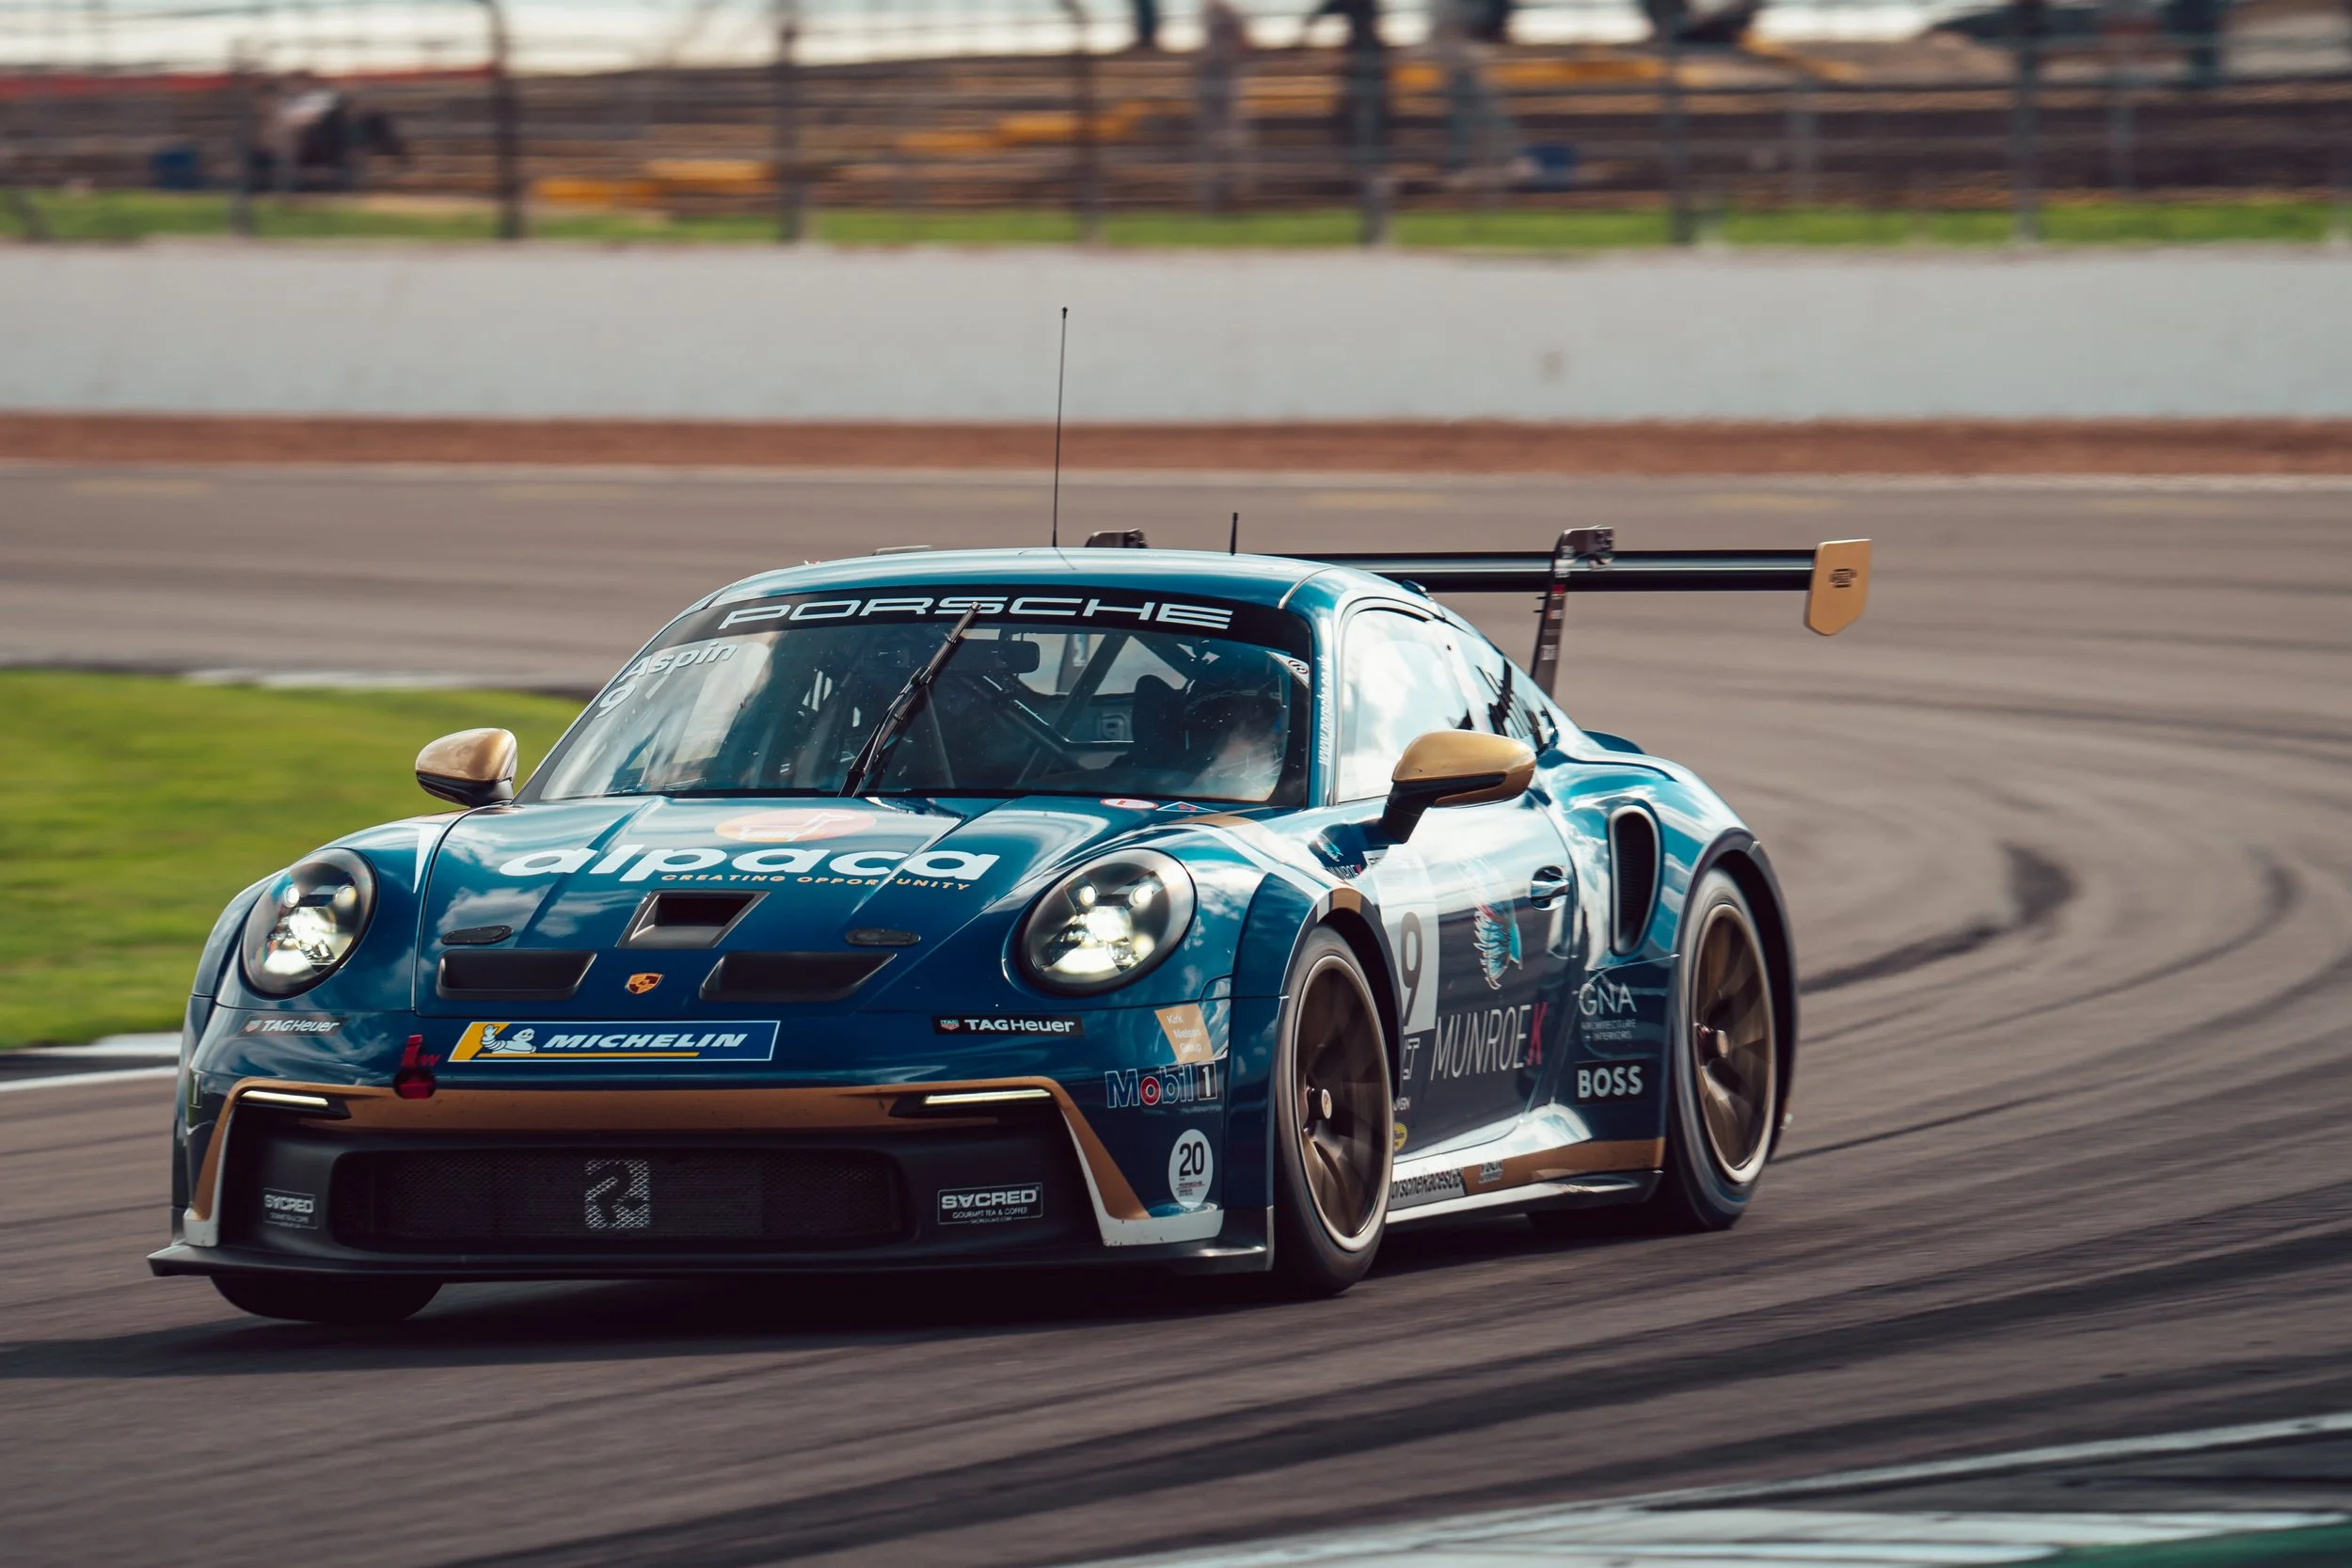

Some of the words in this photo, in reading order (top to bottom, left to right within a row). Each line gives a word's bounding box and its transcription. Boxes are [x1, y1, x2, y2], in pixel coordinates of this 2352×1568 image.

[718, 596, 1233, 630] PORSCHE
[617, 641, 739, 684] Aspin
[499, 844, 1000, 882] alpaca
[797, 876, 971, 890] OPPORUNITY
[1401, 911, 1422, 1027] 9
[1580, 983, 1637, 1016] GNA
[543, 1034, 748, 1048] MICHELIN
[1104, 1064, 1194, 1109] Mobil
[1578, 1065, 1644, 1099] BOSS
[1179, 1141, 1205, 1177] 20
[942, 1189, 1038, 1210] SACRED
